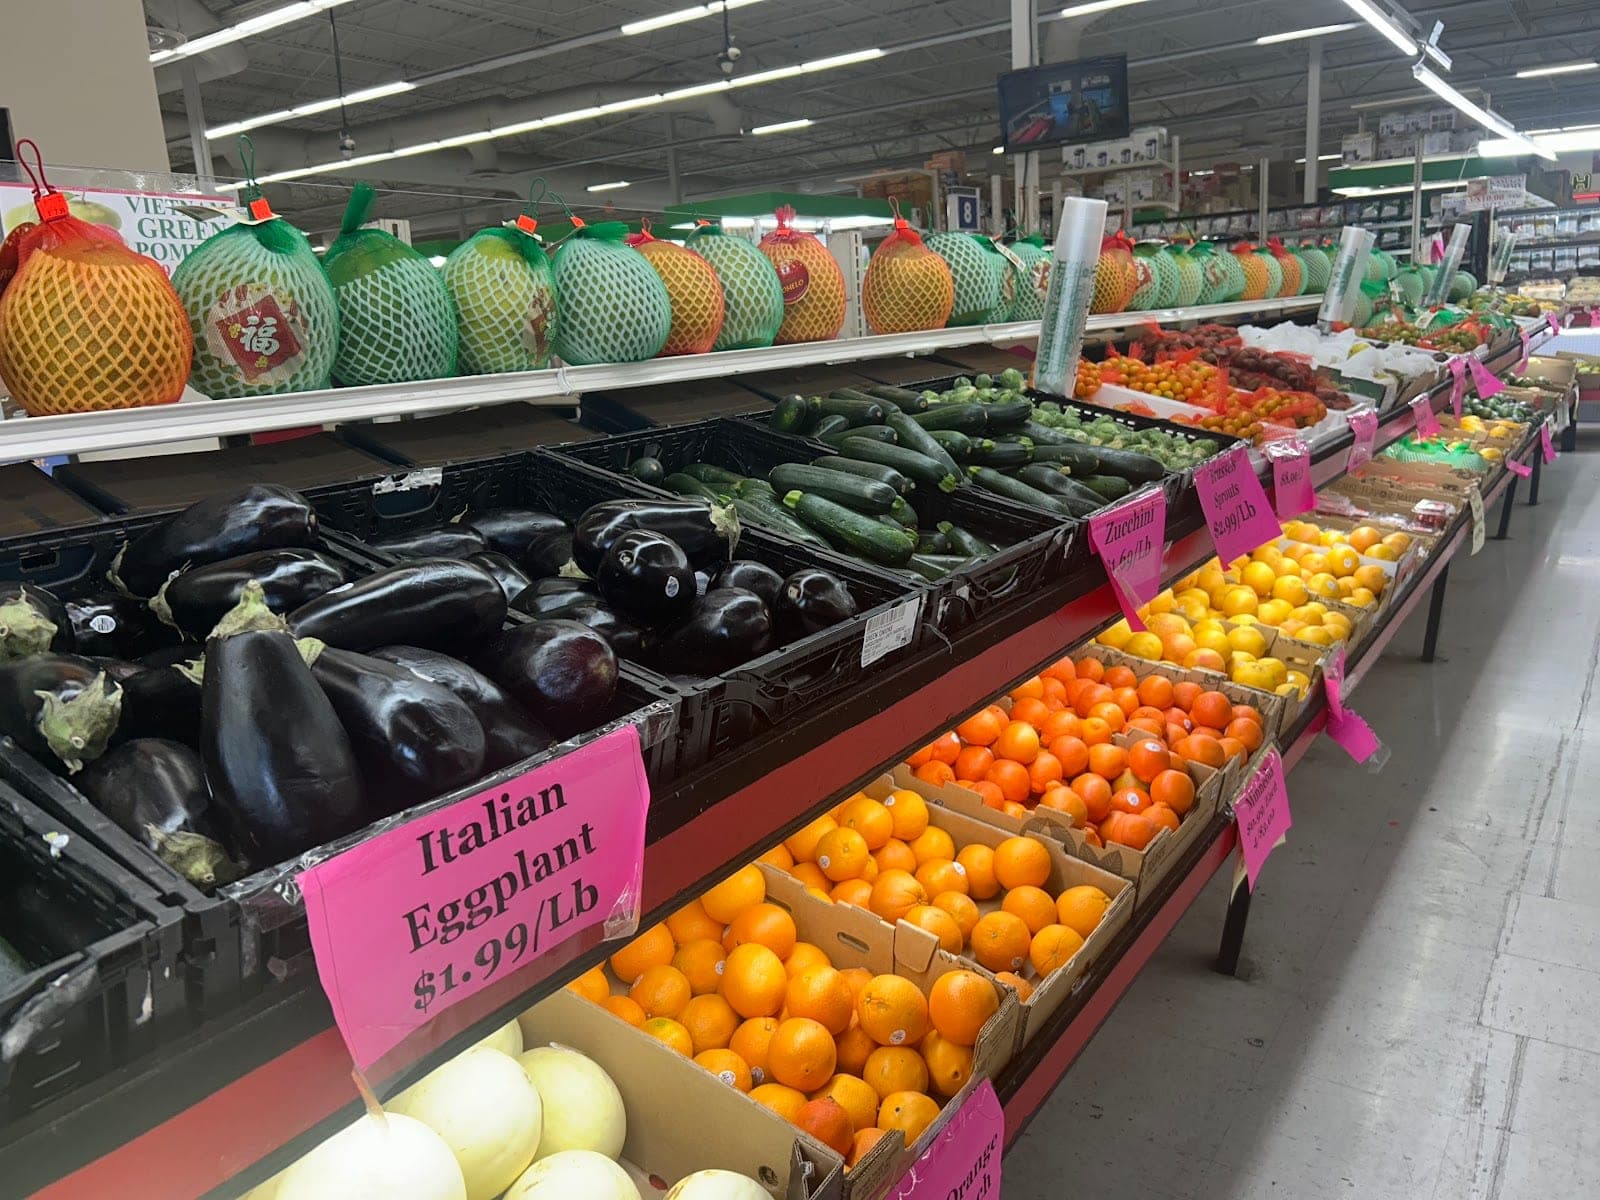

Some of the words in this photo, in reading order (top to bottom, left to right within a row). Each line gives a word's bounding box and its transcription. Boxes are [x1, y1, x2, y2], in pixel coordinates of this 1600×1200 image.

[125, 196, 228, 218] VIET
[963, 201, 972, 224] 8
[137, 217, 227, 241] GREEN
[240, 315, 280, 356] 福
[1214, 483, 1240, 510] Sprouts
[1104, 502, 1155, 546] Zucchini
[1213, 500, 1256, 539] $2.99/Lb
[416, 782, 567, 876] Italian
[402, 822, 597, 954] Eggplant
[413, 878, 599, 1014] $1.99/Lb
